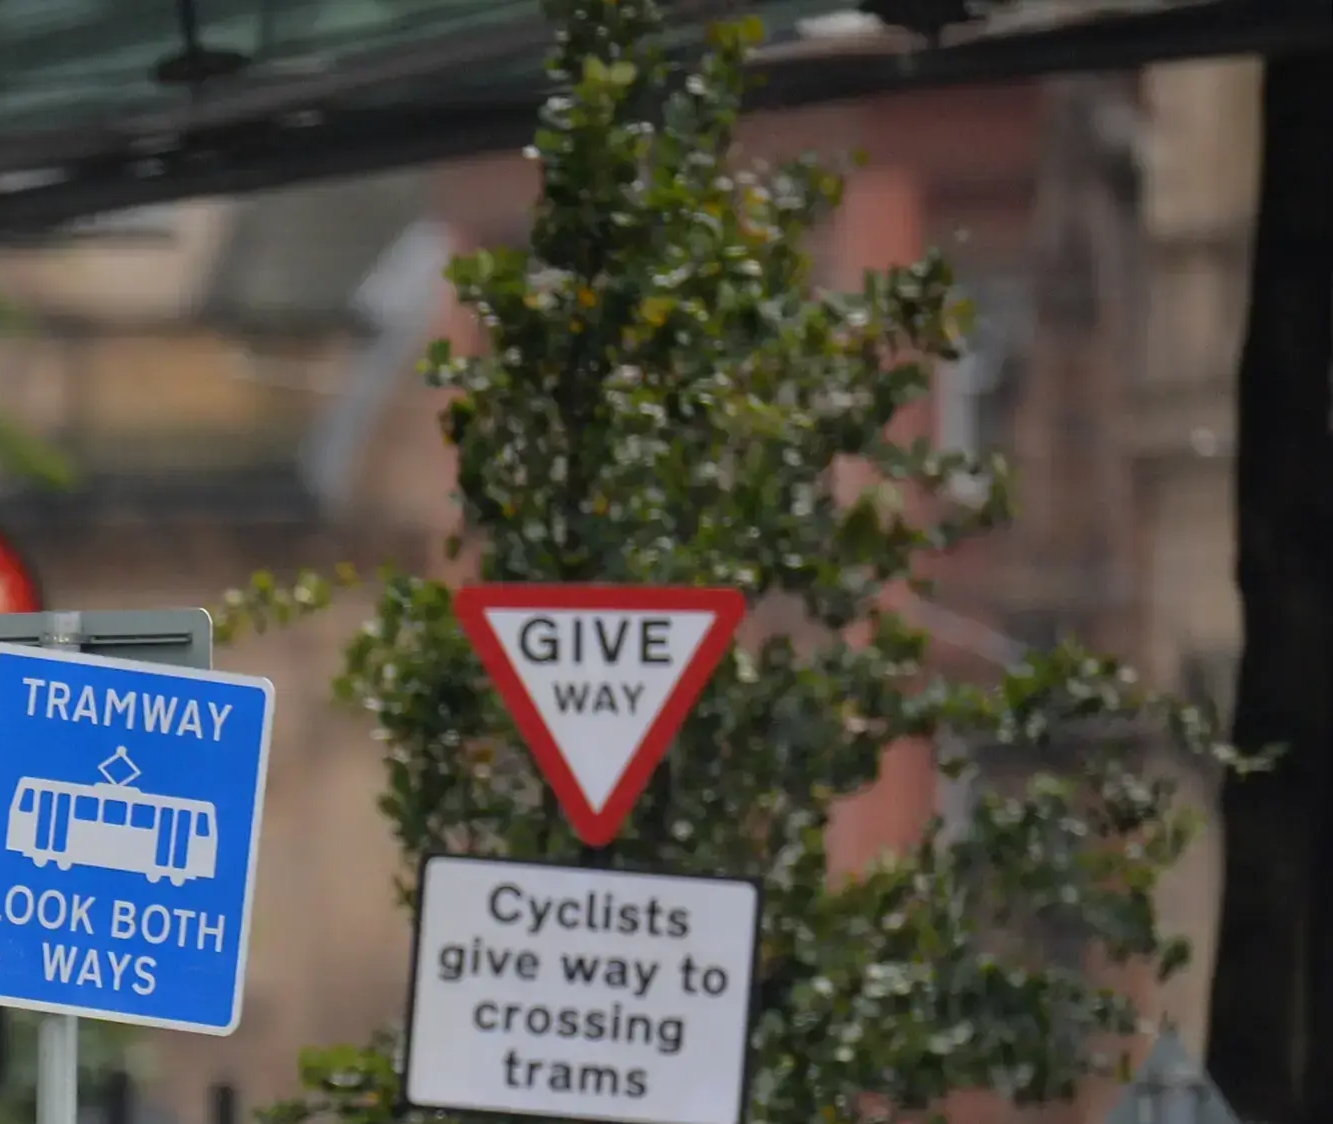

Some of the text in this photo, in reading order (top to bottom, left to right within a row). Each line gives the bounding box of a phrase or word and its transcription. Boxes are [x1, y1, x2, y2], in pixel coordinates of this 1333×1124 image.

[519, 617, 673, 664] GIVE
[23, 677, 232, 742] TRAMWAY
[553, 681, 645, 715] WAY
[111, 899, 226, 952] BOTH
[489, 884, 689, 938] Cyclists
[43, 942, 157, 995] WAYS
[438, 937, 728, 998] give way to
[473, 999, 685, 1054] crossing
[503, 1051, 648, 1097] trams
